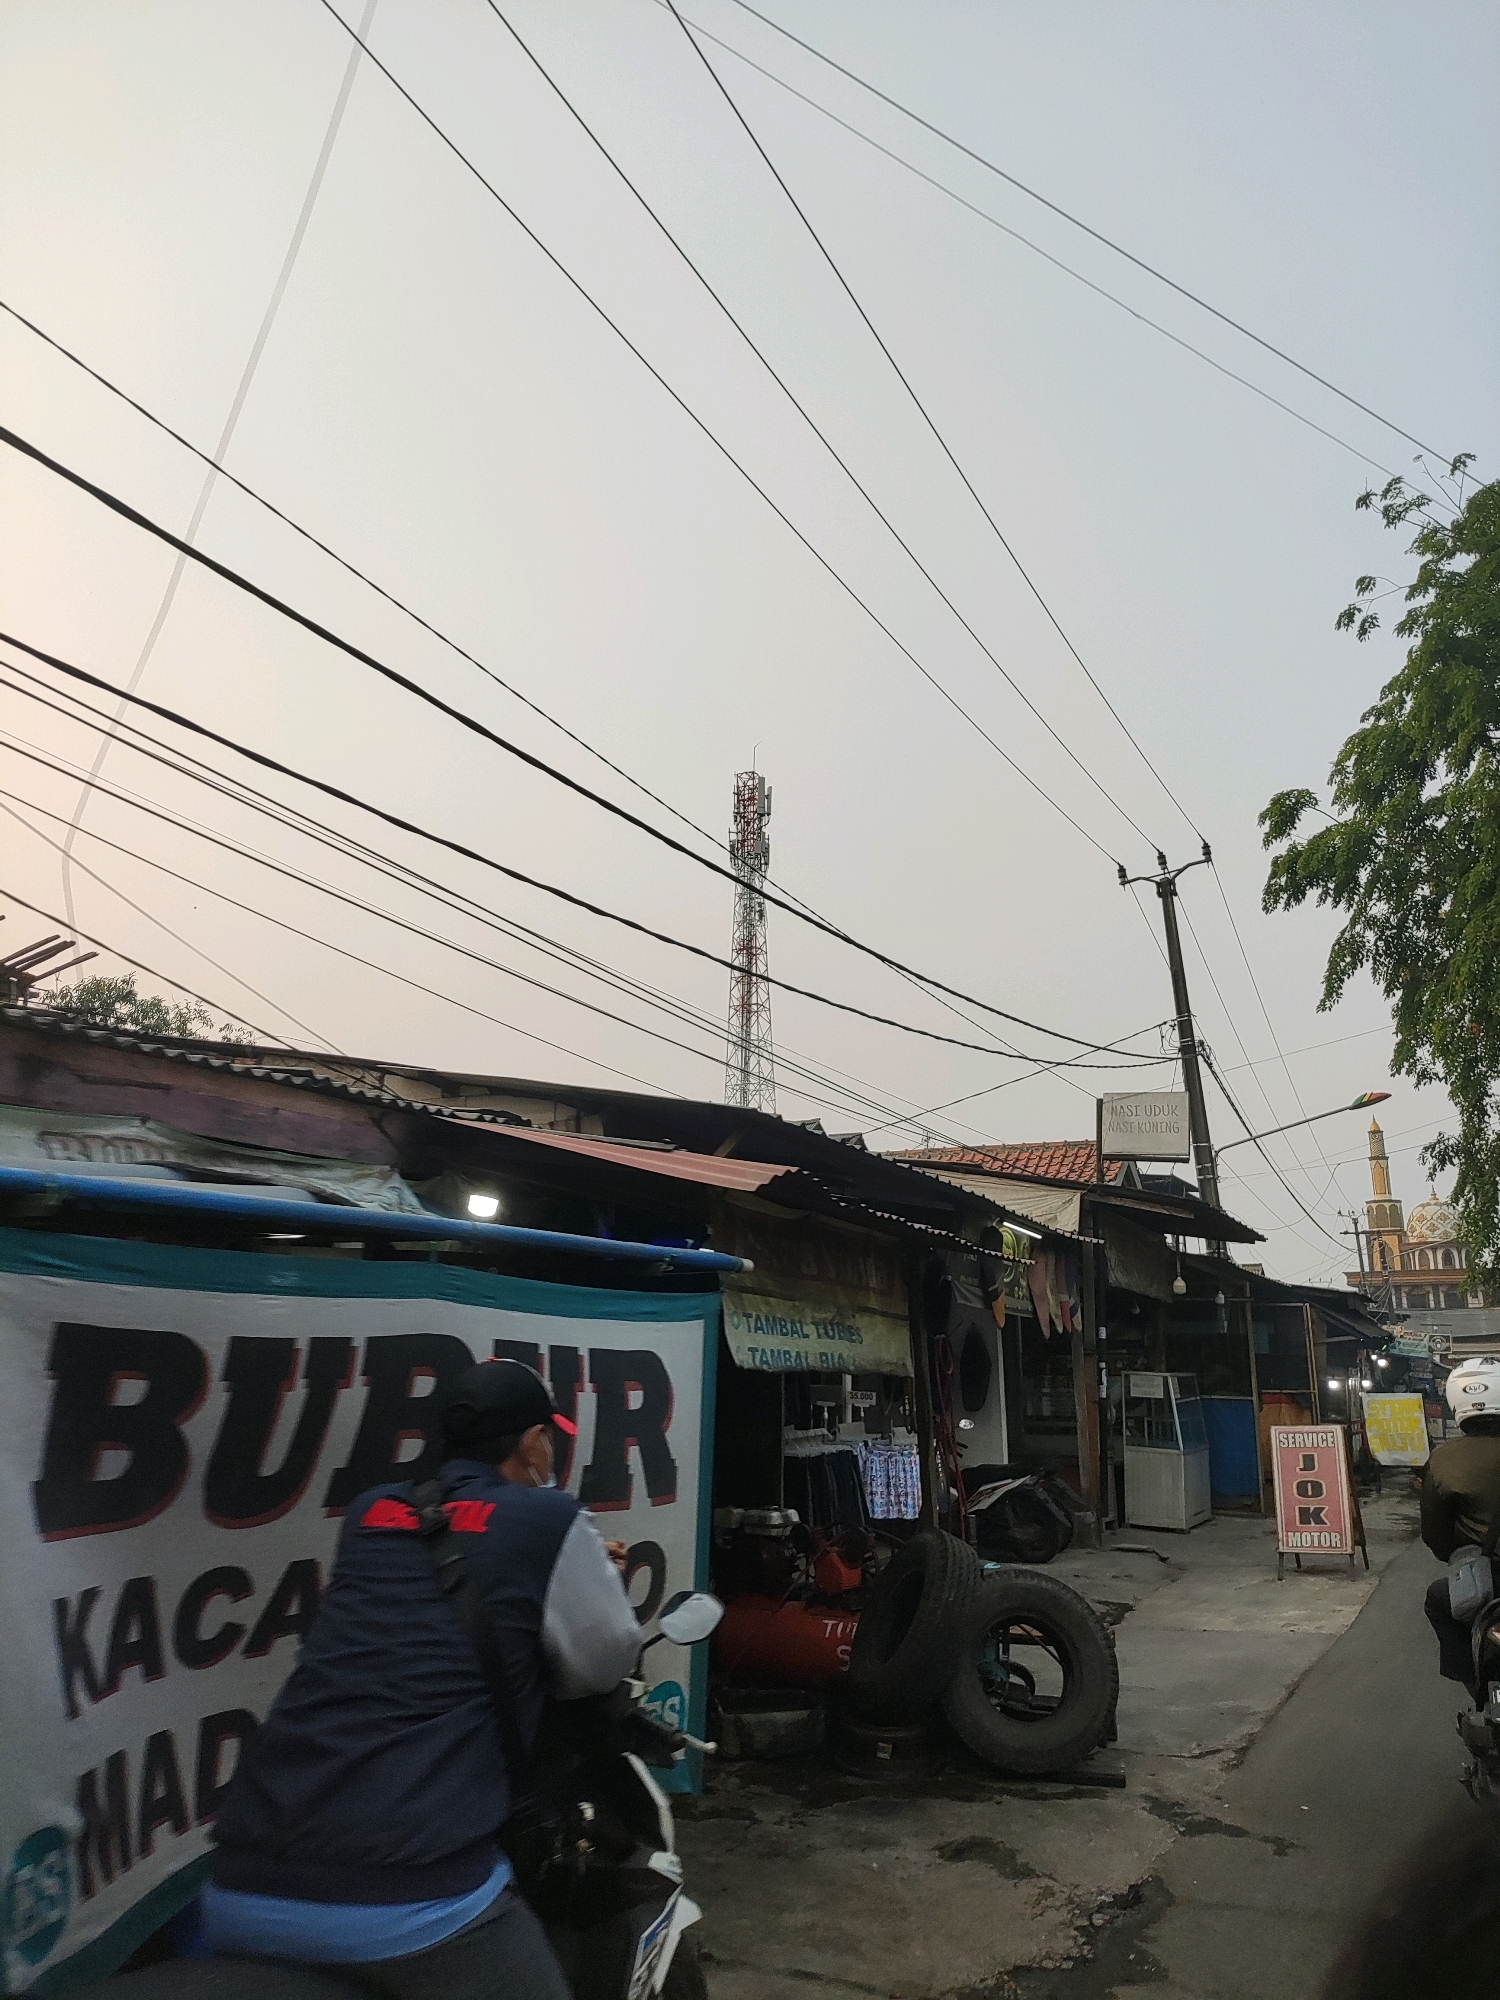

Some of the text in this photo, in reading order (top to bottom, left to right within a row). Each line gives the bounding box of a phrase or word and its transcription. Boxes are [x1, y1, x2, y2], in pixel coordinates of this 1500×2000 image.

[1111, 1103, 1179, 1117] NASI UDUK
[1108, 1120, 1180, 1134] NASI KUNING
[742, 1312, 810, 1339] TAMBAL
[1280, 1432, 1335, 1448] SERVICE
[1293, 1452, 1331, 1526] JOK
[1288, 1532, 1341, 1548] MOTOR
